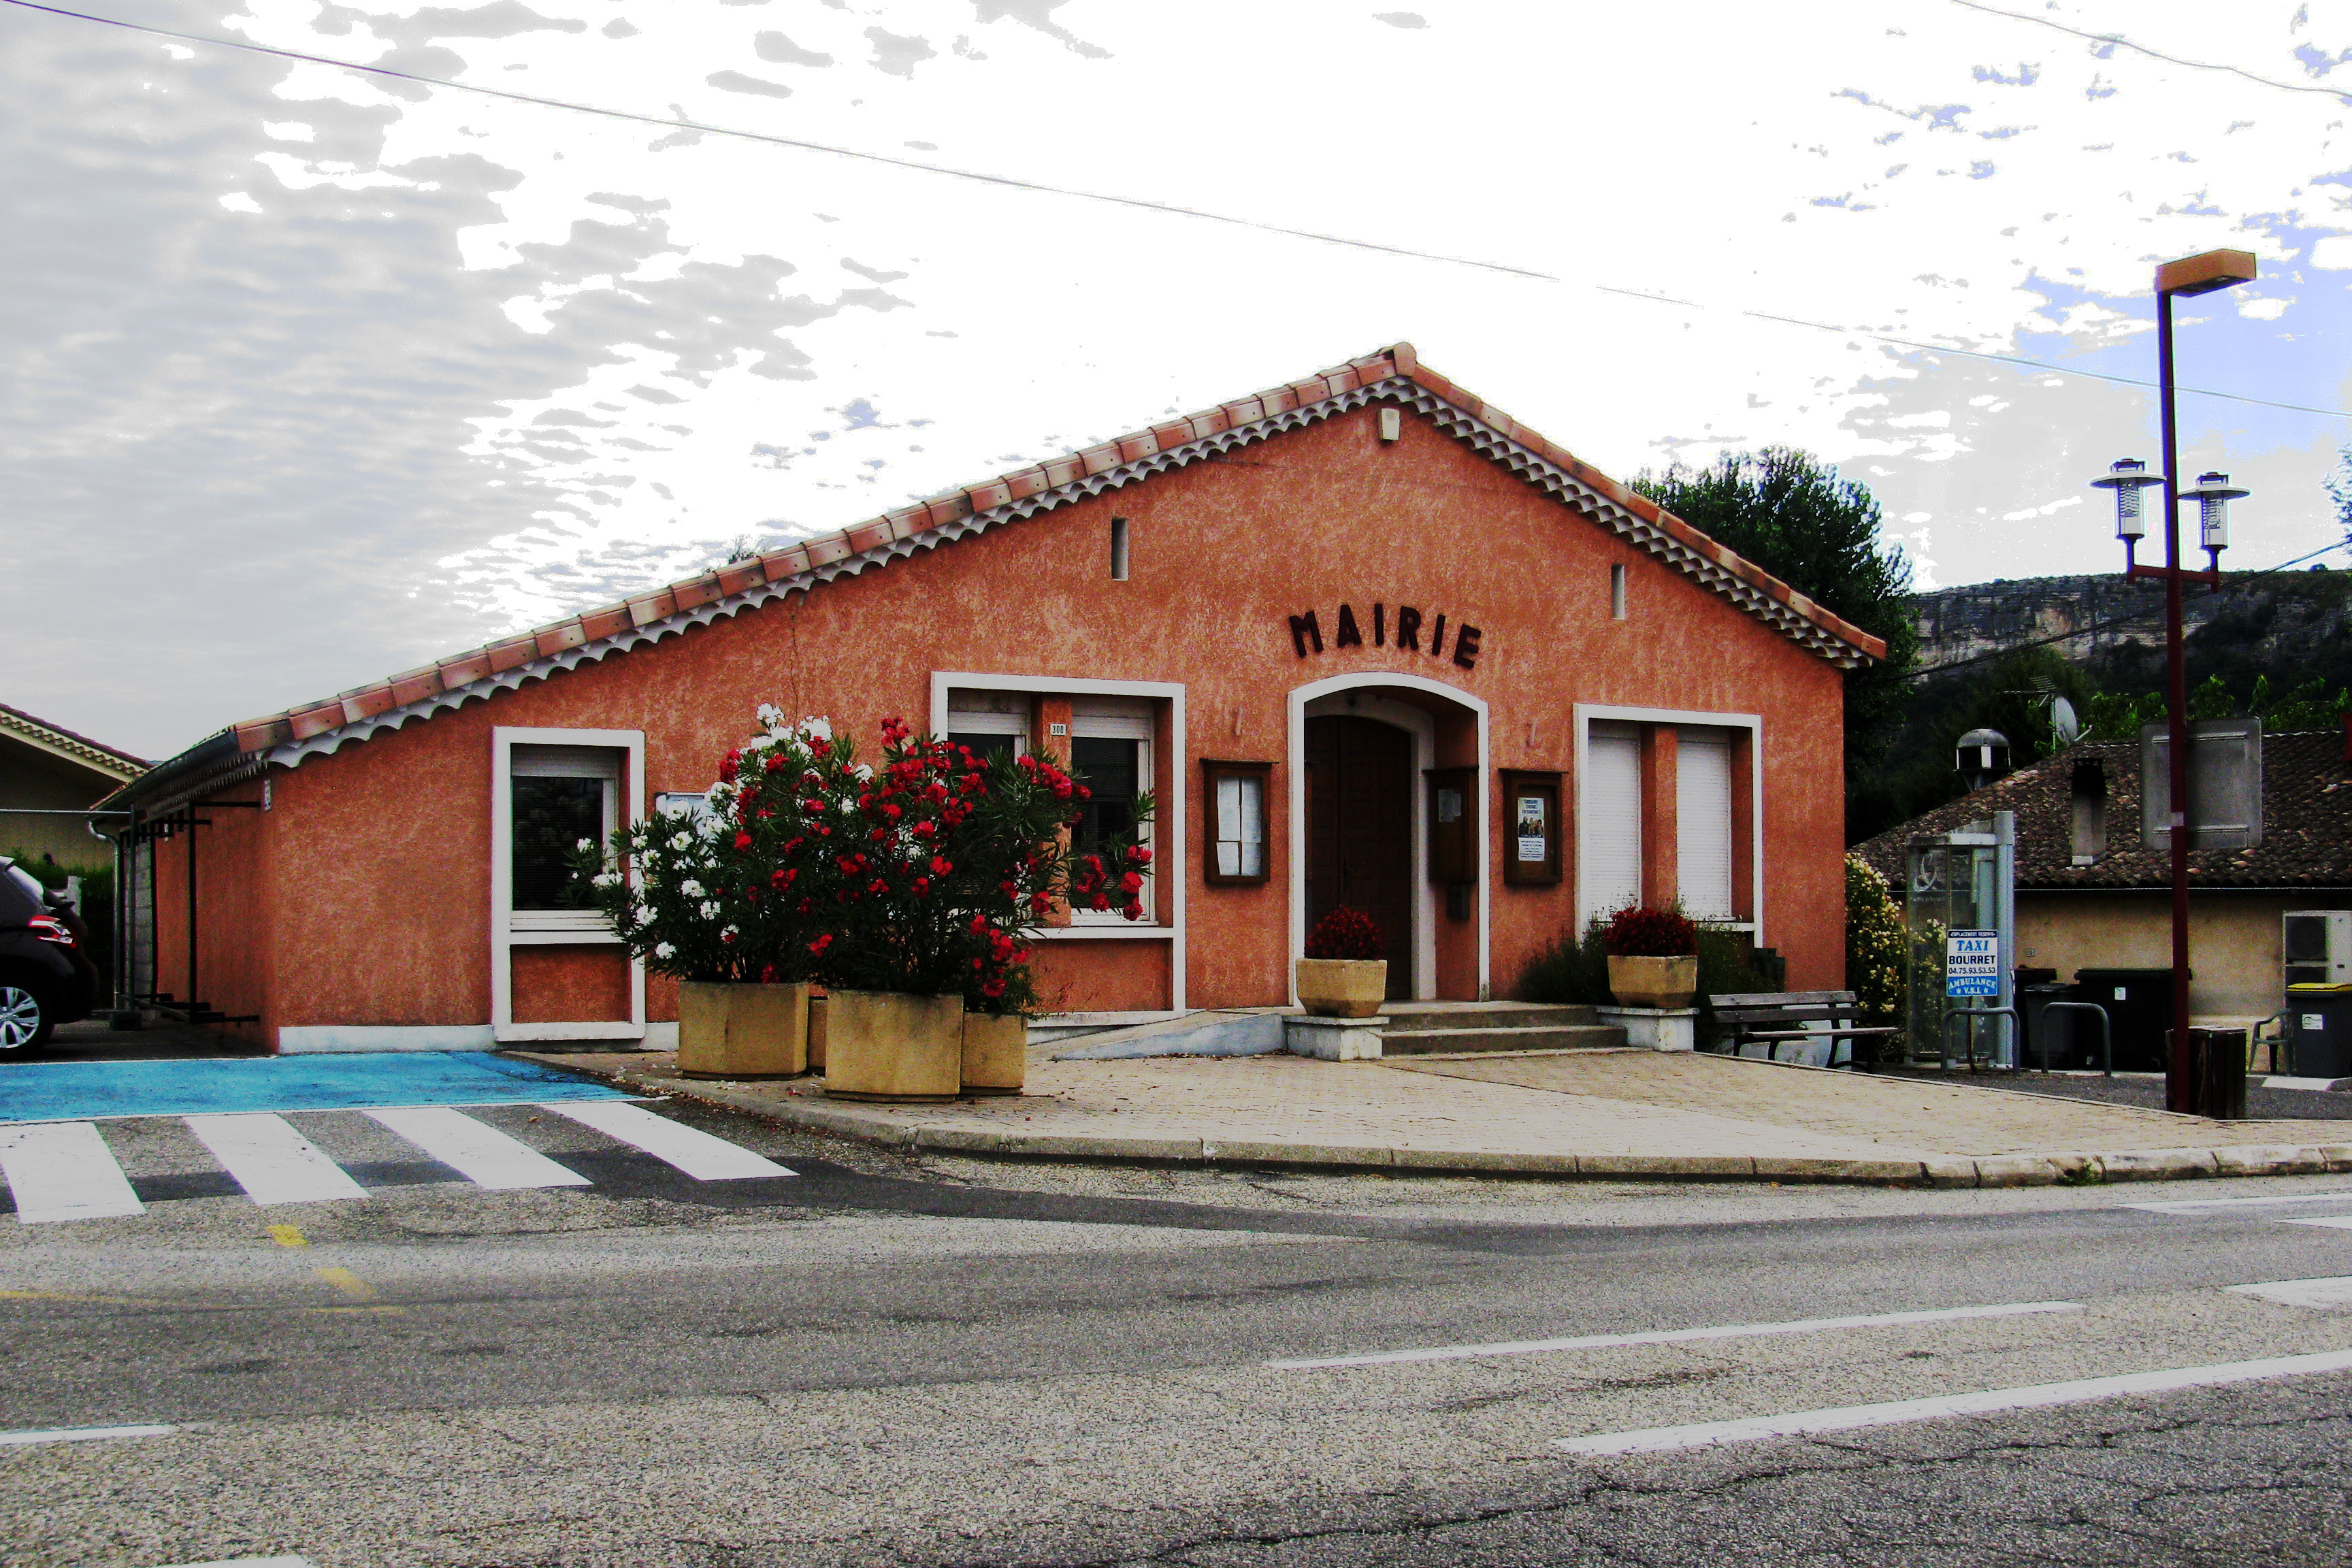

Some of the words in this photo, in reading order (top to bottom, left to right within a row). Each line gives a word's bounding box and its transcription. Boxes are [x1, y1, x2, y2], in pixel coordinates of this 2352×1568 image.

[1289, 603, 1482, 670] MAIRIE
[1957, 941, 1989, 951] TAXI
[1949, 956, 1995, 964] BOURRET
[1948, 977, 1996, 990] AMBULANCE
